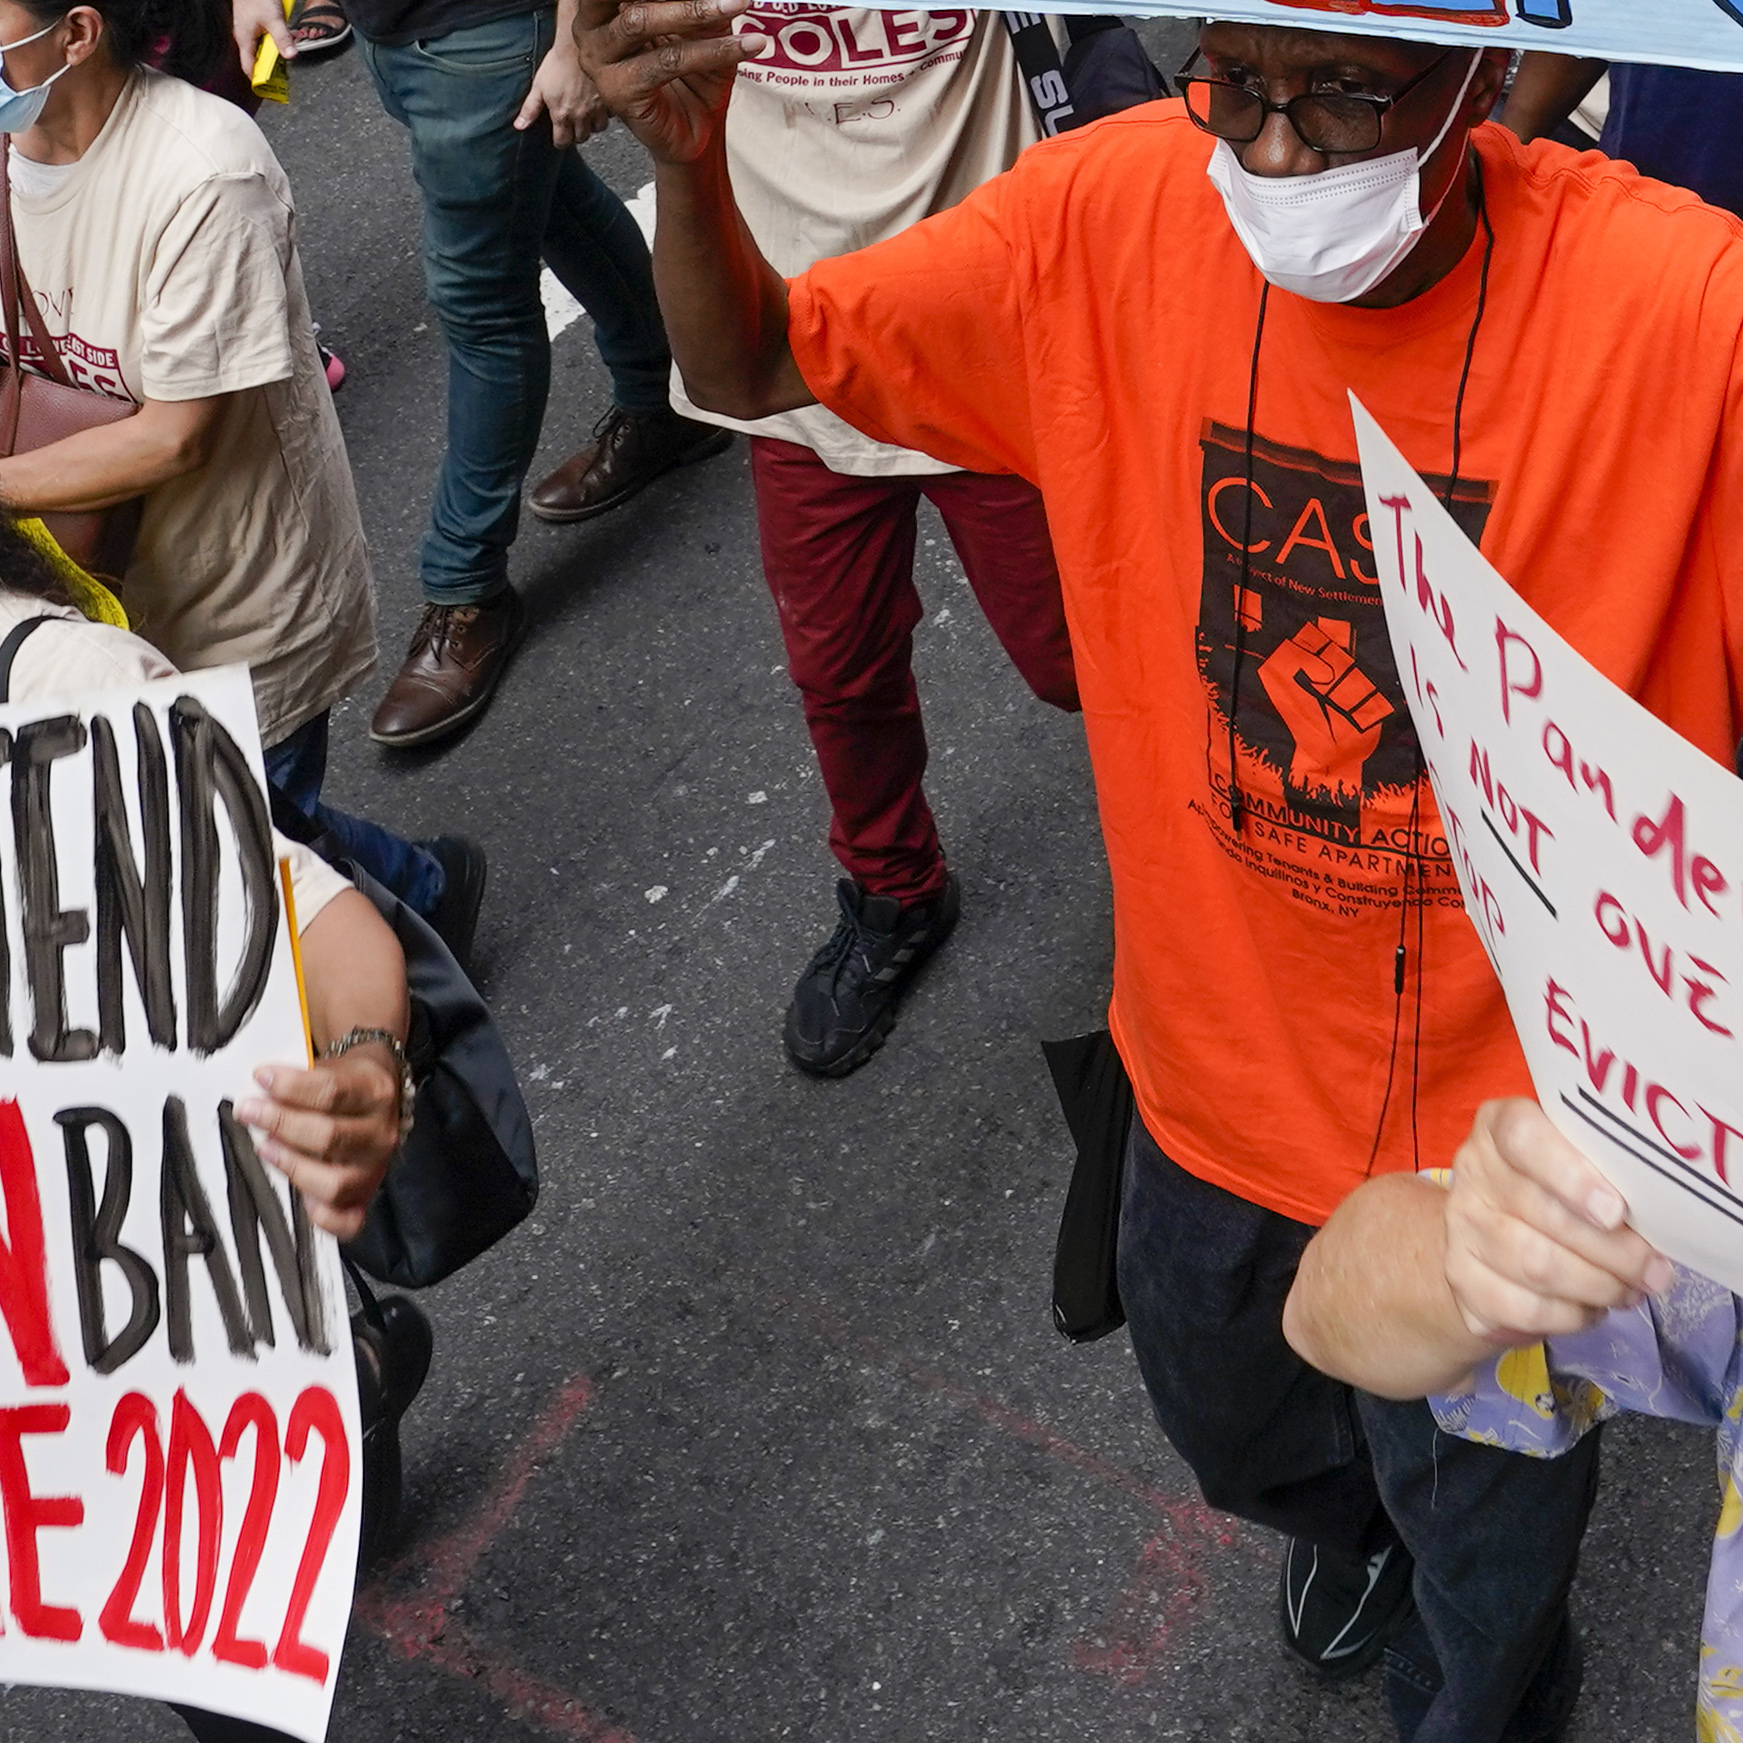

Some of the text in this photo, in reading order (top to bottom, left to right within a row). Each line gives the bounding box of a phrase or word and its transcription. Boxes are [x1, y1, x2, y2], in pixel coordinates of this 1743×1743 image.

[766, 70, 905, 88] People in their Homes
[85, 344, 115, 366] SIDE
[1274, 574, 1286, 587] of
[1288, 577, 1316, 597] New
[1317, 586, 1384, 607] Settlemen
[1378, 492, 1468, 674] The
[1468, 731, 1556, 882] NOT
[1255, 821, 1308, 854] SAFE
[1244, 858, 1434, 909] Inquilinos y Construyendo
[1266, 851, 1398, 898] Tenants & Building
[1291, 887, 1360, 919] Bronx, NY
[52, 1092, 337, 1376] BAN
[97, 1381, 353, 1687] 2022
